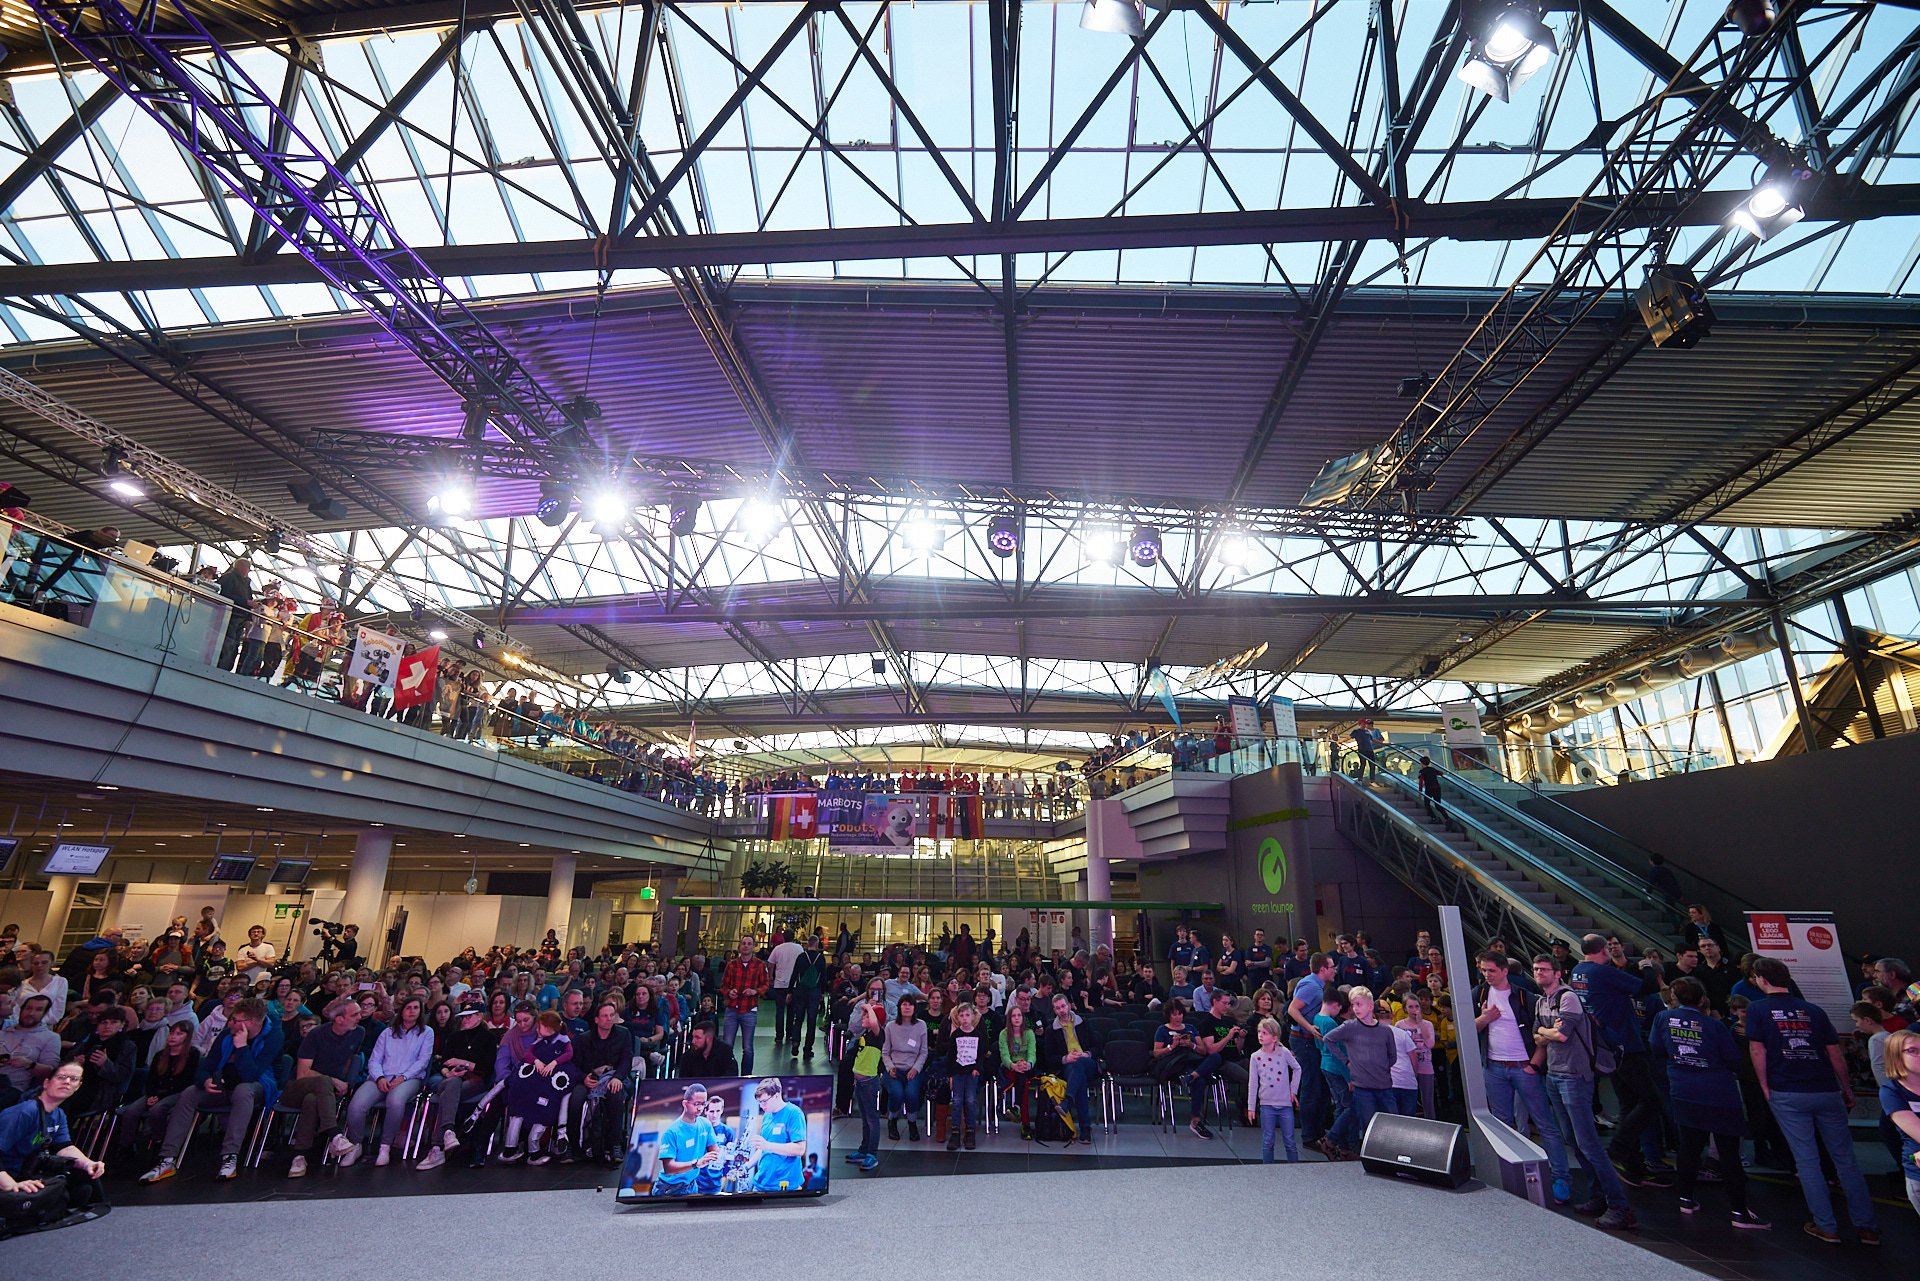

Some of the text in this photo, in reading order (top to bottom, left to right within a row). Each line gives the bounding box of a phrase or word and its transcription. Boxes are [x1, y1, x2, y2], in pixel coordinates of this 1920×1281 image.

[817, 798, 863, 810] MARBOTS
[81, 846, 106, 855] Hotspot
[1251, 900, 1295, 914] green lounge
[1776, 1021, 1809, 1031] FINAL
[1670, 1028, 1702, 1040] FINAL
